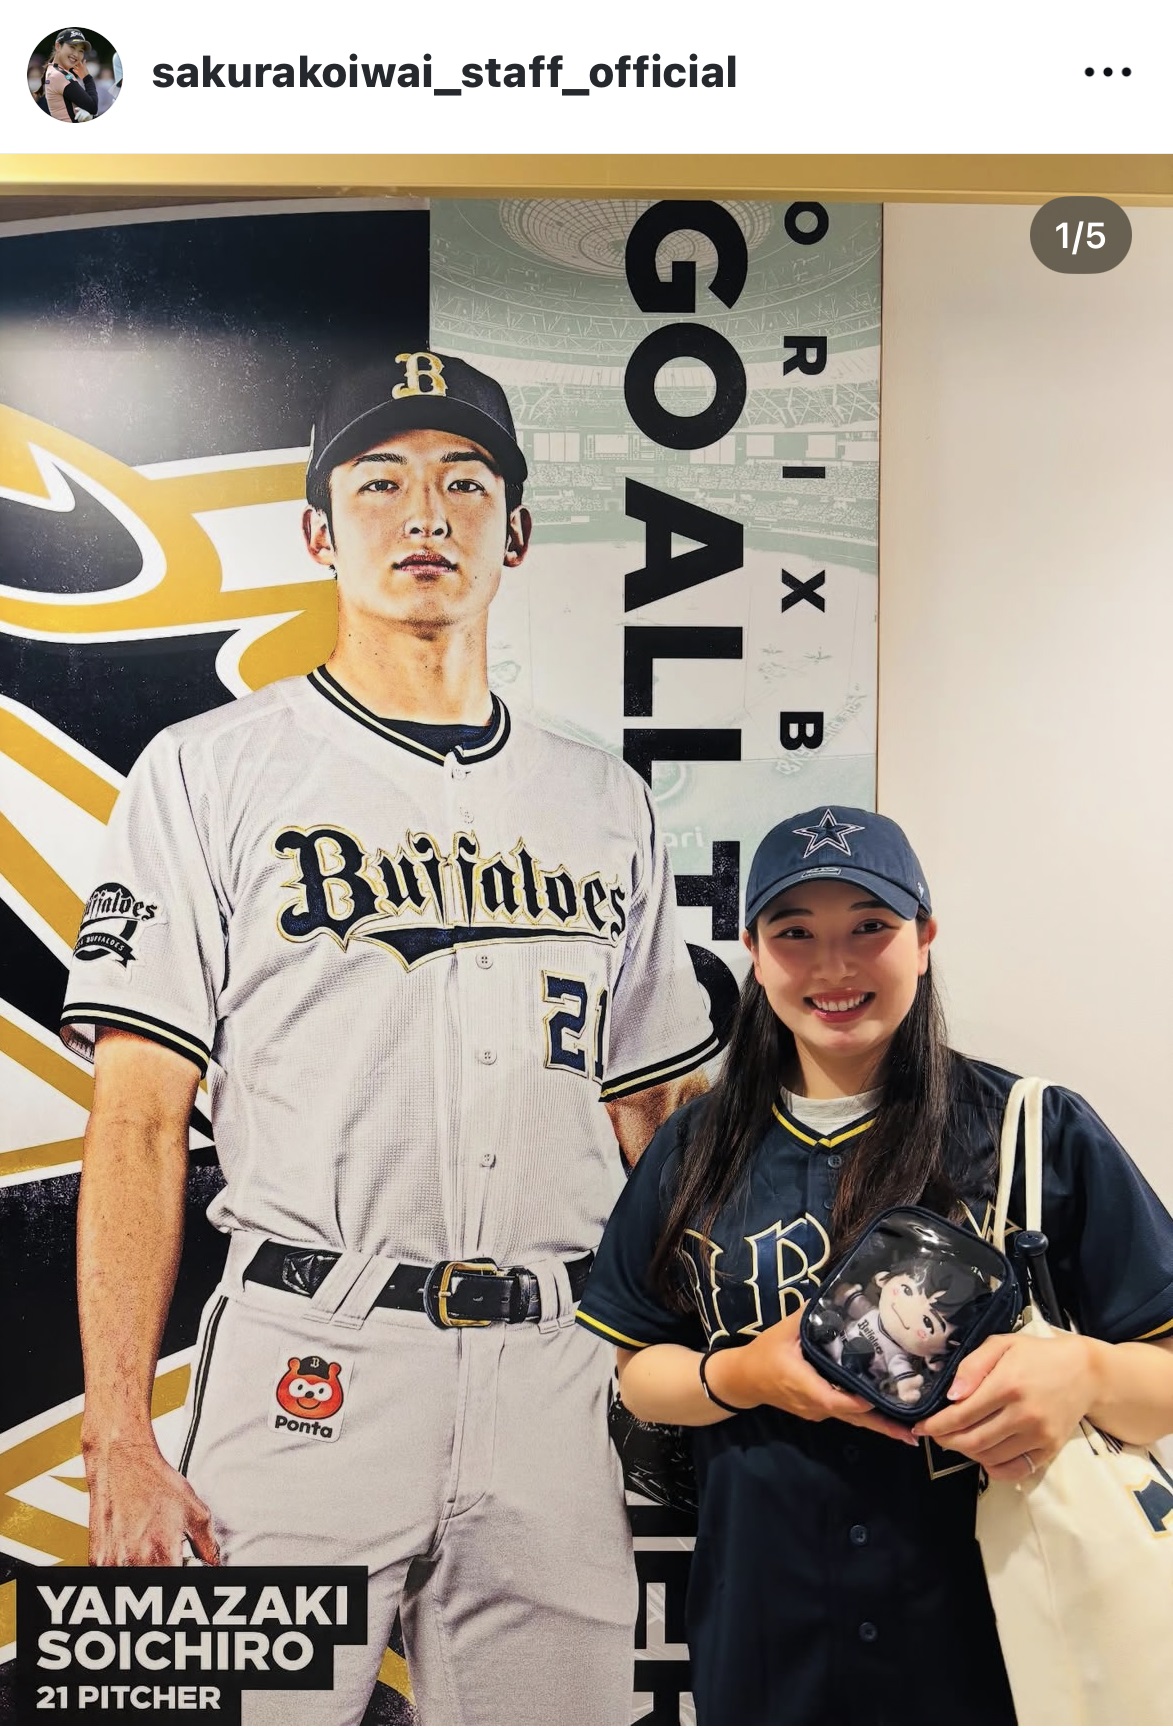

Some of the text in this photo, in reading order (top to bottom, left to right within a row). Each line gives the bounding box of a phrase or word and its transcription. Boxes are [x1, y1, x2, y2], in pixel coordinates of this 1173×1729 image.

[623, 200, 748, 450] GO
[391, 351, 448, 400] B
[274, 824, 626, 953] Buffaloes
[274, 1415, 333, 1439] Ponta
[36, 1585, 348, 1626] YAMAZAKI
[36, 1630, 315, 1672] SOICHIRO
[36, 1685, 222, 1710] 21 PITCHER
